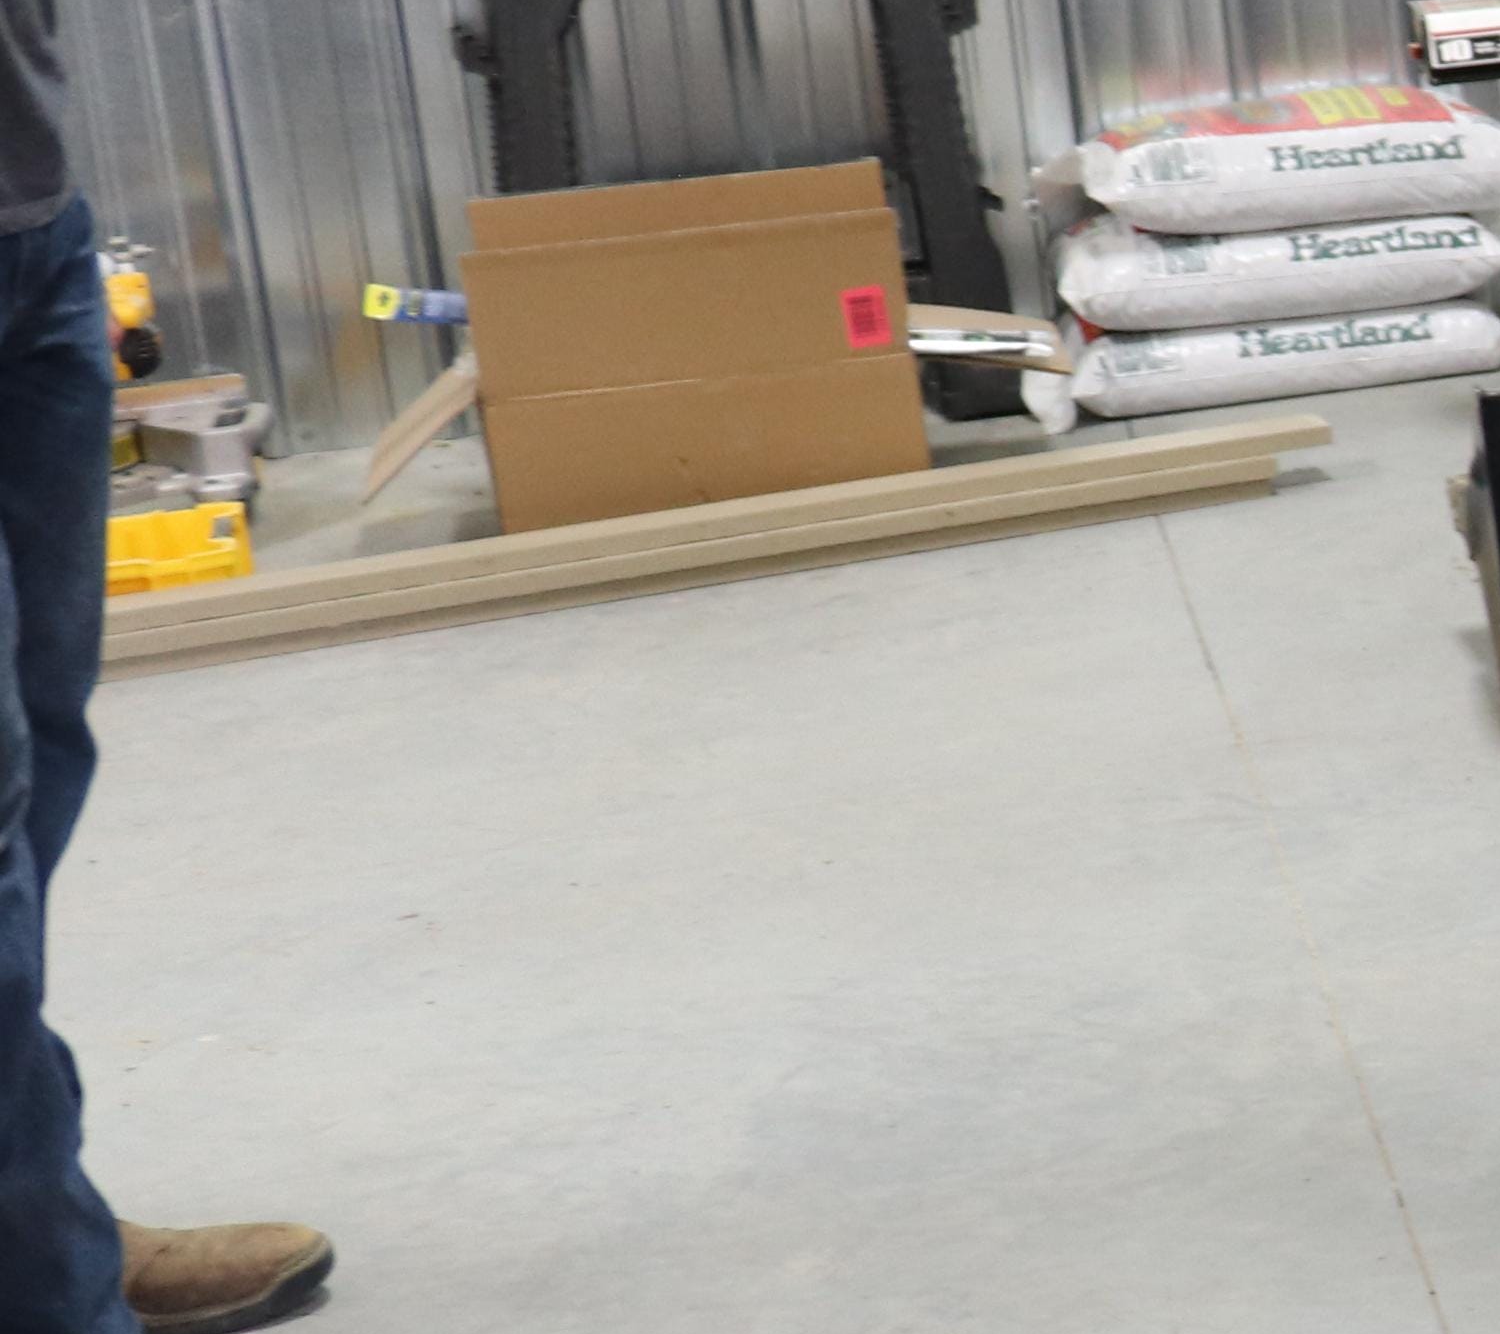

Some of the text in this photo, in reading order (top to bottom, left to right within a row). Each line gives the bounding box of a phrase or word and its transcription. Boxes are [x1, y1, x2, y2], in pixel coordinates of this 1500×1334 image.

[1267, 134, 1467, 172] Heartland
[1288, 224, 1483, 262] Heartland
[1236, 312, 1434, 358] Heartland
